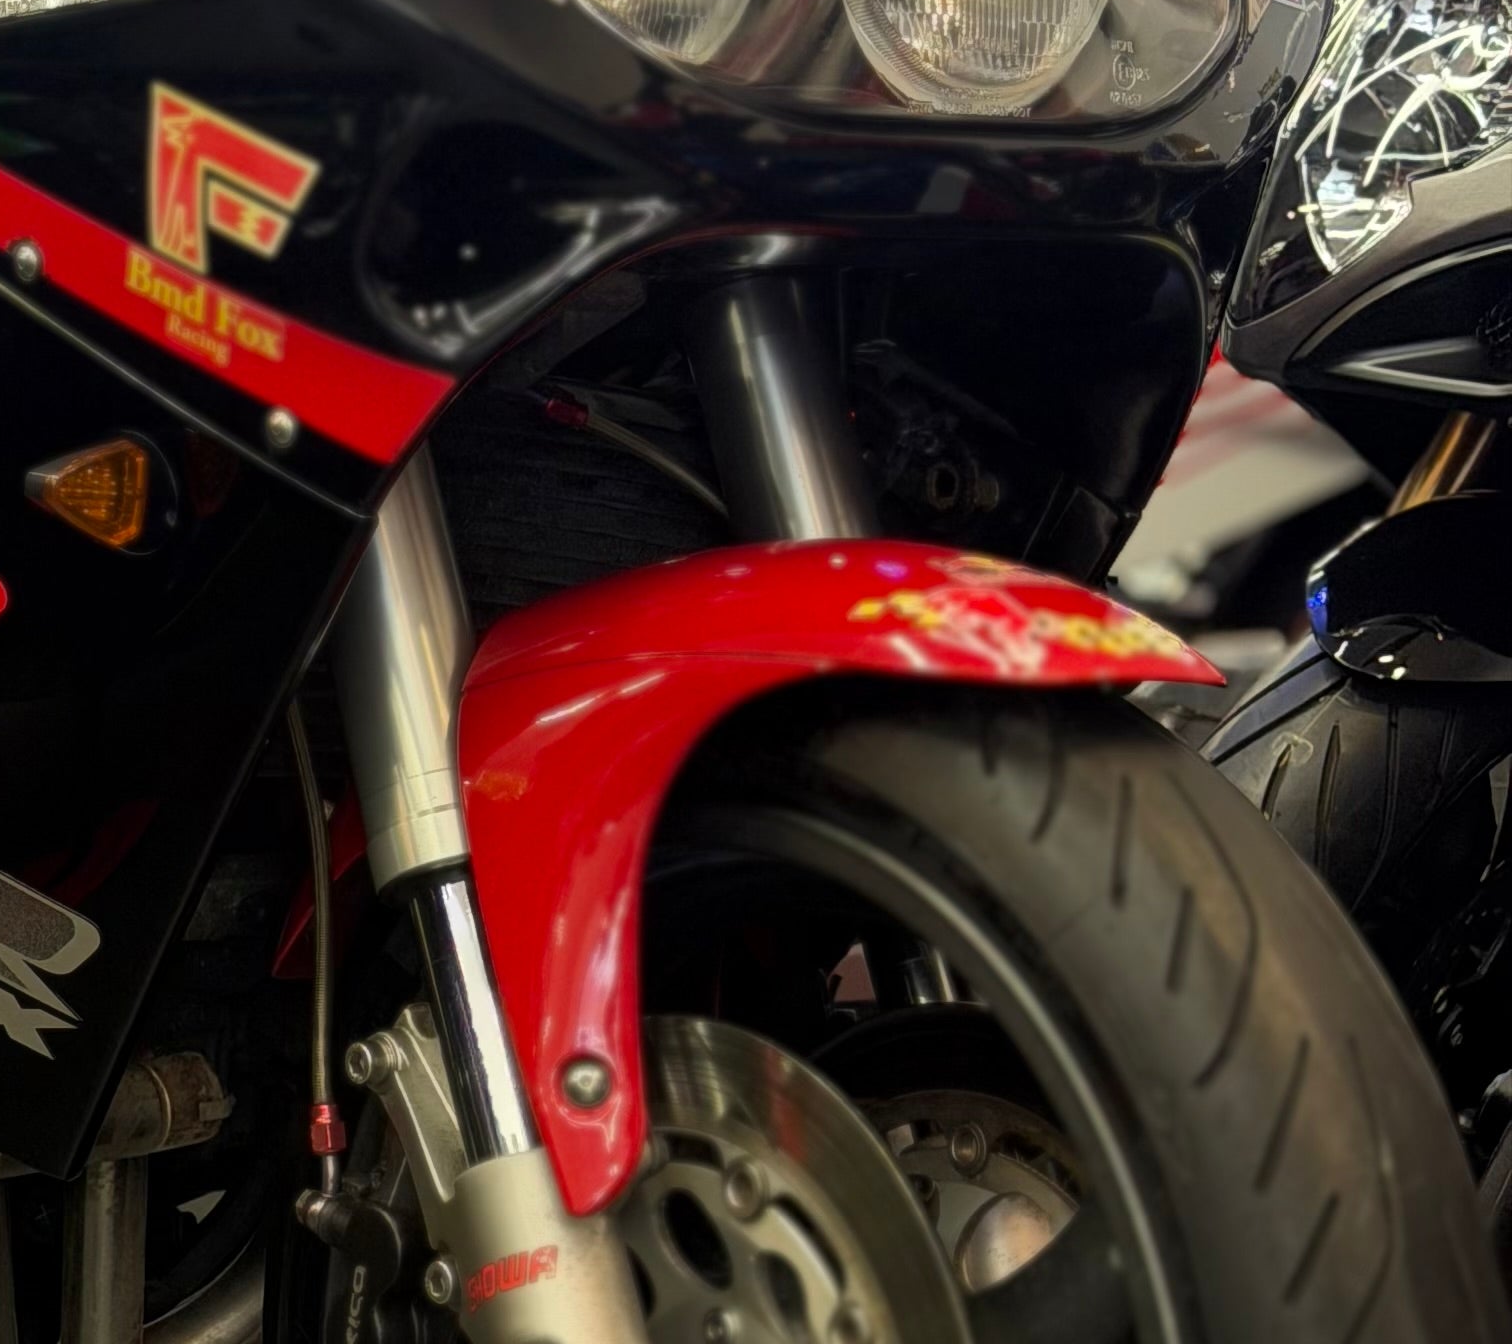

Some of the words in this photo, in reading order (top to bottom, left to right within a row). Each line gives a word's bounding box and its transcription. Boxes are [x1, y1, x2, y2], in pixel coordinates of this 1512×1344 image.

[127, 246, 207, 324] Bmd
[215, 298, 286, 362] Fox
[166, 312, 230, 369] Racing
[467, 1243, 559, 1313] SHOWA
